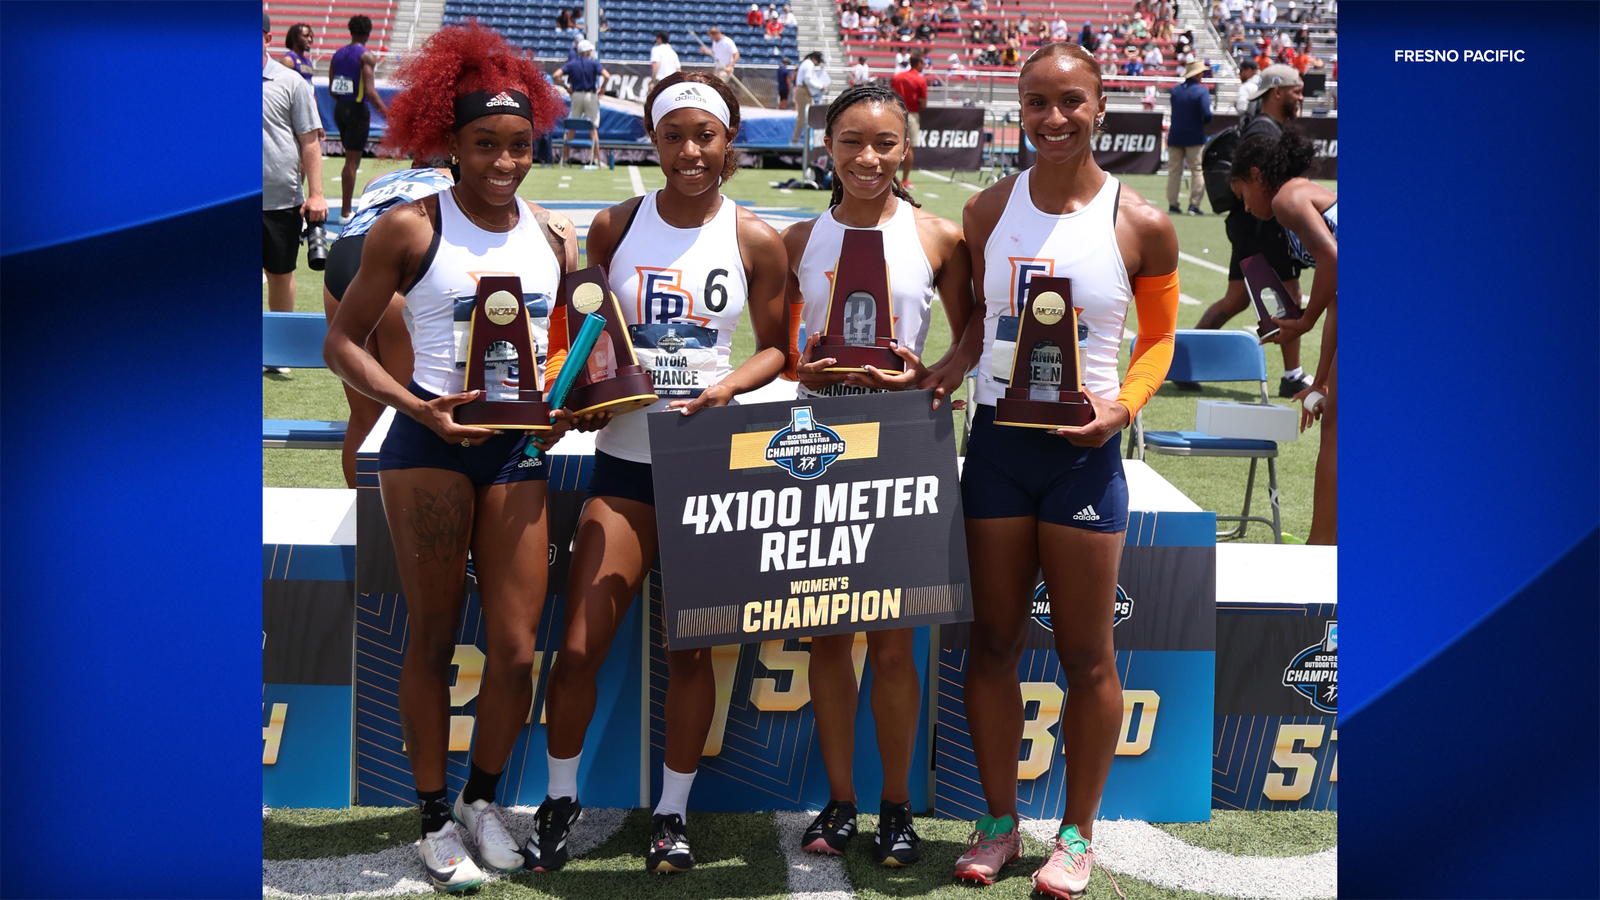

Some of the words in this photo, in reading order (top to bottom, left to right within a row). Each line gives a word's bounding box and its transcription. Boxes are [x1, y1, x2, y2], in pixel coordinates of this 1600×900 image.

[334, 81, 349, 91] 225
[486, 98, 520, 109] adidas
[928, 129, 940, 148] &
[940, 129, 980, 148] FIELD
[1099, 133, 1113, 152] &
[1113, 133, 1156, 152] FIELD
[703, 268, 729, 313] 6
[488, 306, 518, 316] NCAA
[1034, 306, 1064, 316] NCAA
[654, 355, 688, 367] NYDIA
[645, 370, 699, 385] HANCE
[767, 442, 844, 458] CHAMPIONSHIPS
[682, 487, 802, 535] 4X100
[813, 475, 939, 524] METER
[759, 523, 876, 573] RELAY
[790, 576, 849, 595] WOMEN'S
[742, 587, 902, 633] CHAMPION
